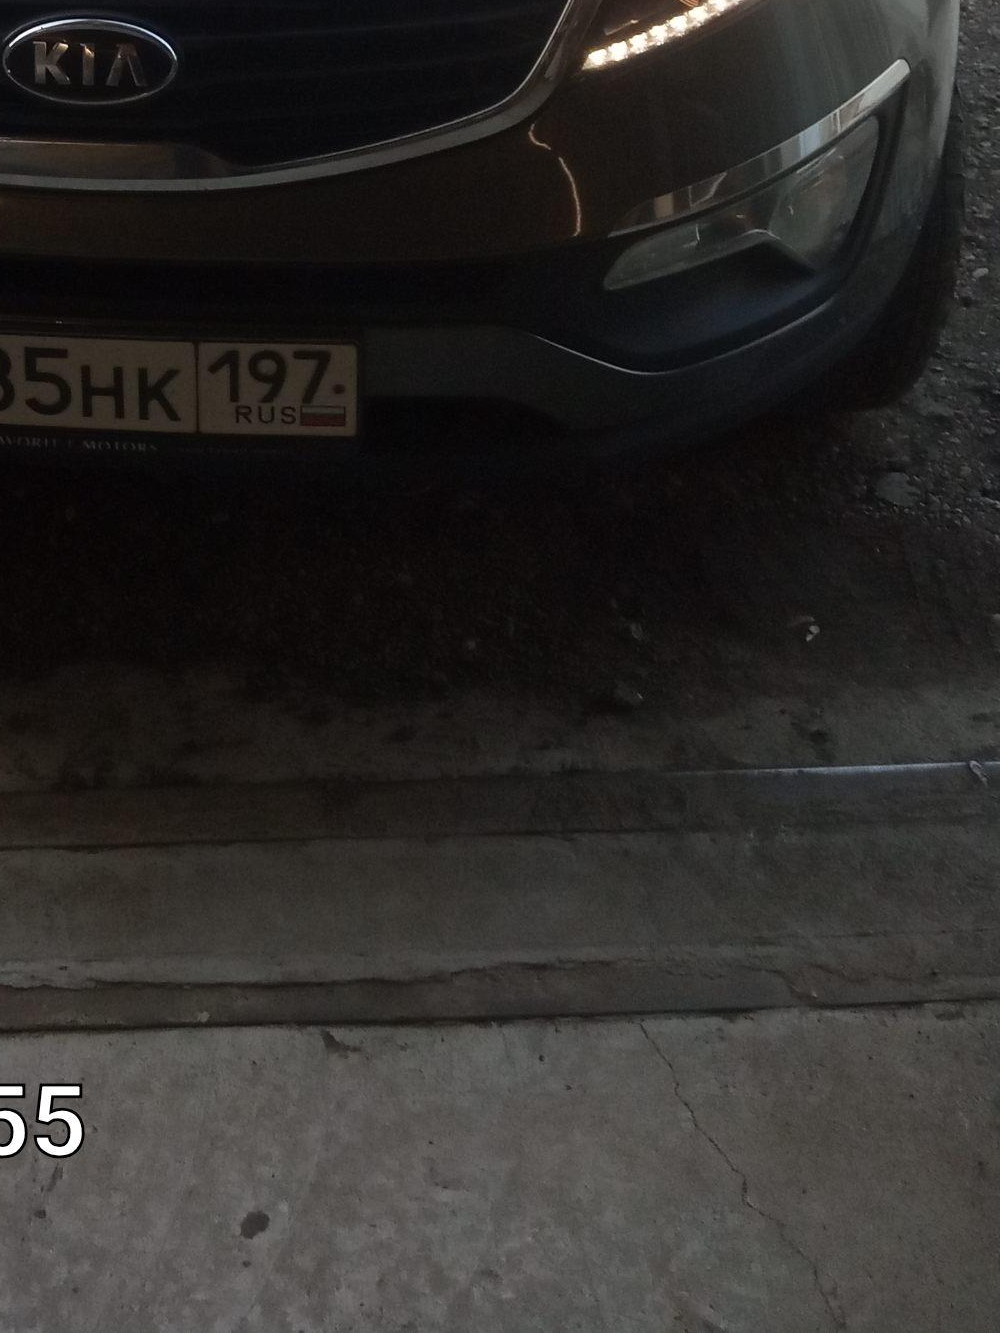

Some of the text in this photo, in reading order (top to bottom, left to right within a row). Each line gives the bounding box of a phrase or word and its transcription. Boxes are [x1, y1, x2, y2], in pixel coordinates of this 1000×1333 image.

[33, 41, 147, 87] KIA
[207, 350, 332, 404] 197
[234, 404, 297, 425] RUS
